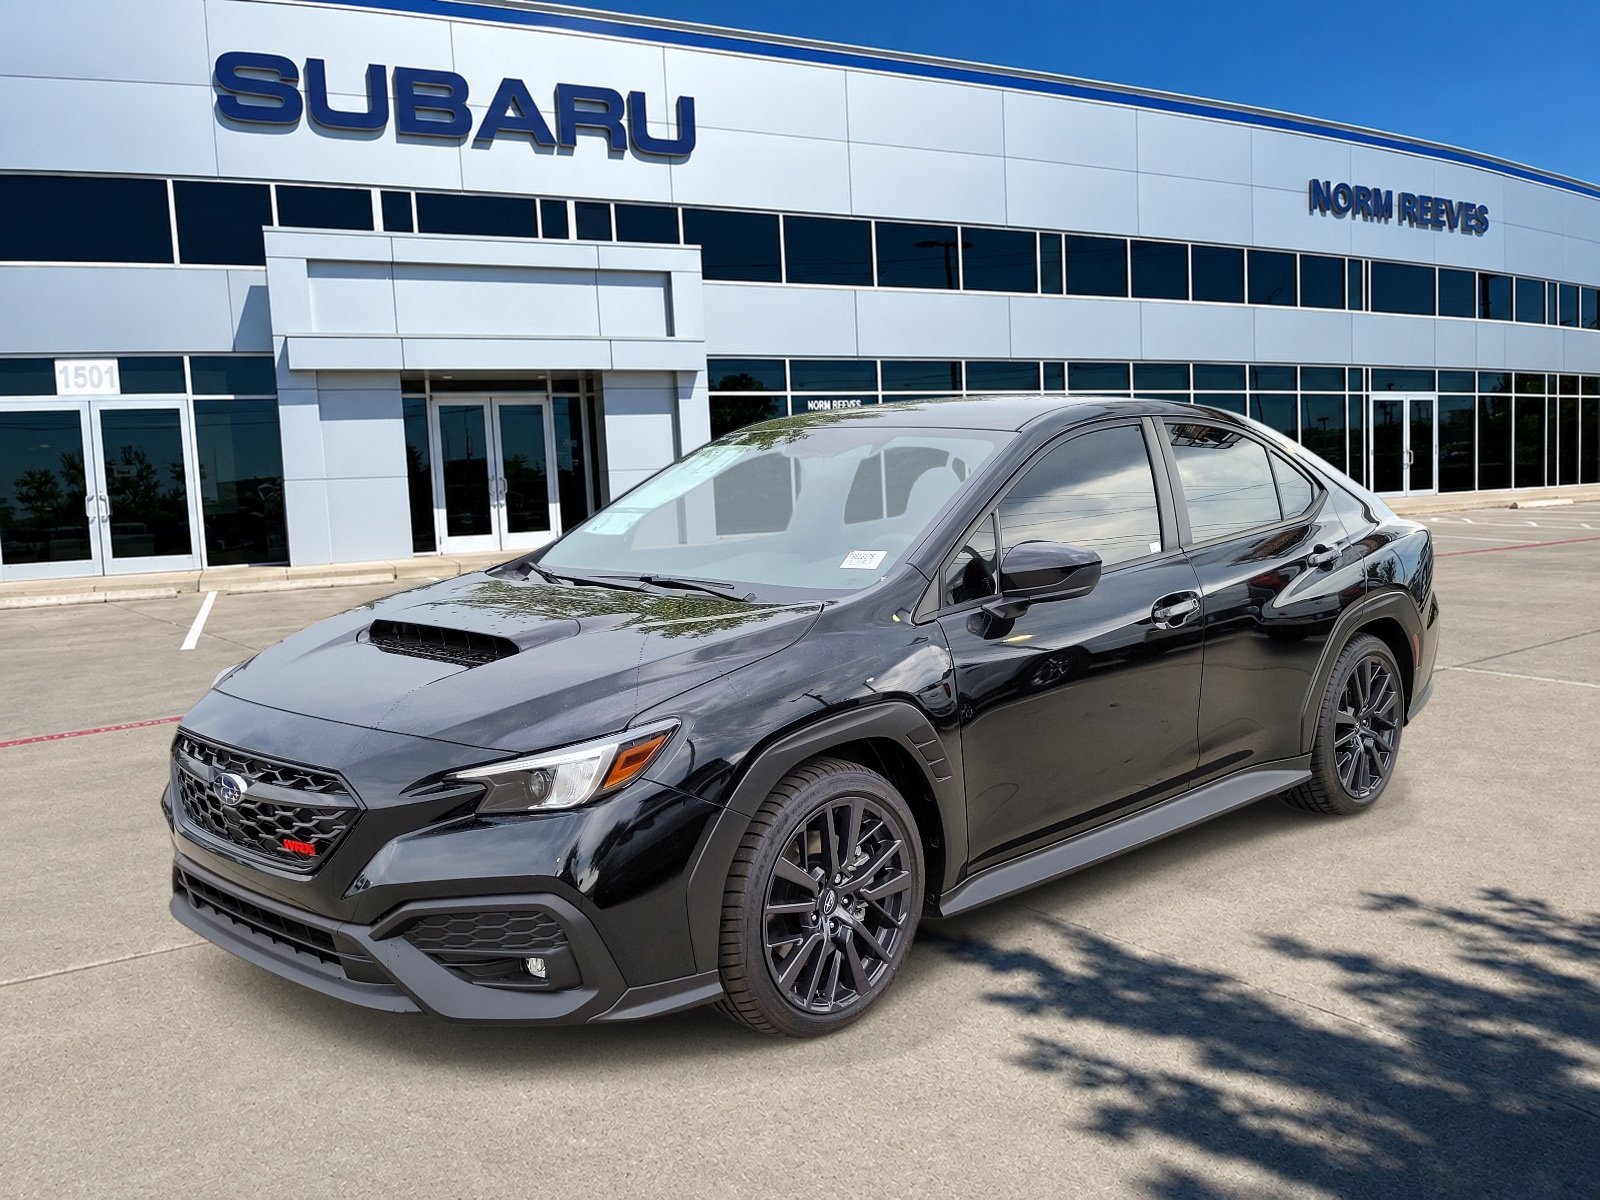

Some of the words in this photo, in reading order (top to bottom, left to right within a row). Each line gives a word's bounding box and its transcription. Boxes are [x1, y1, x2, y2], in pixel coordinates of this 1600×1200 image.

[214, 51, 696, 156] SUBARU
[1309, 178, 1393, 221] NORM
[1398, 191, 1490, 235] REEVES
[59, 364, 116, 389] 1501
[807, 400, 831, 411] NORM
[832, 400, 862, 410] REEVES
[283, 839, 316, 856] WRX
